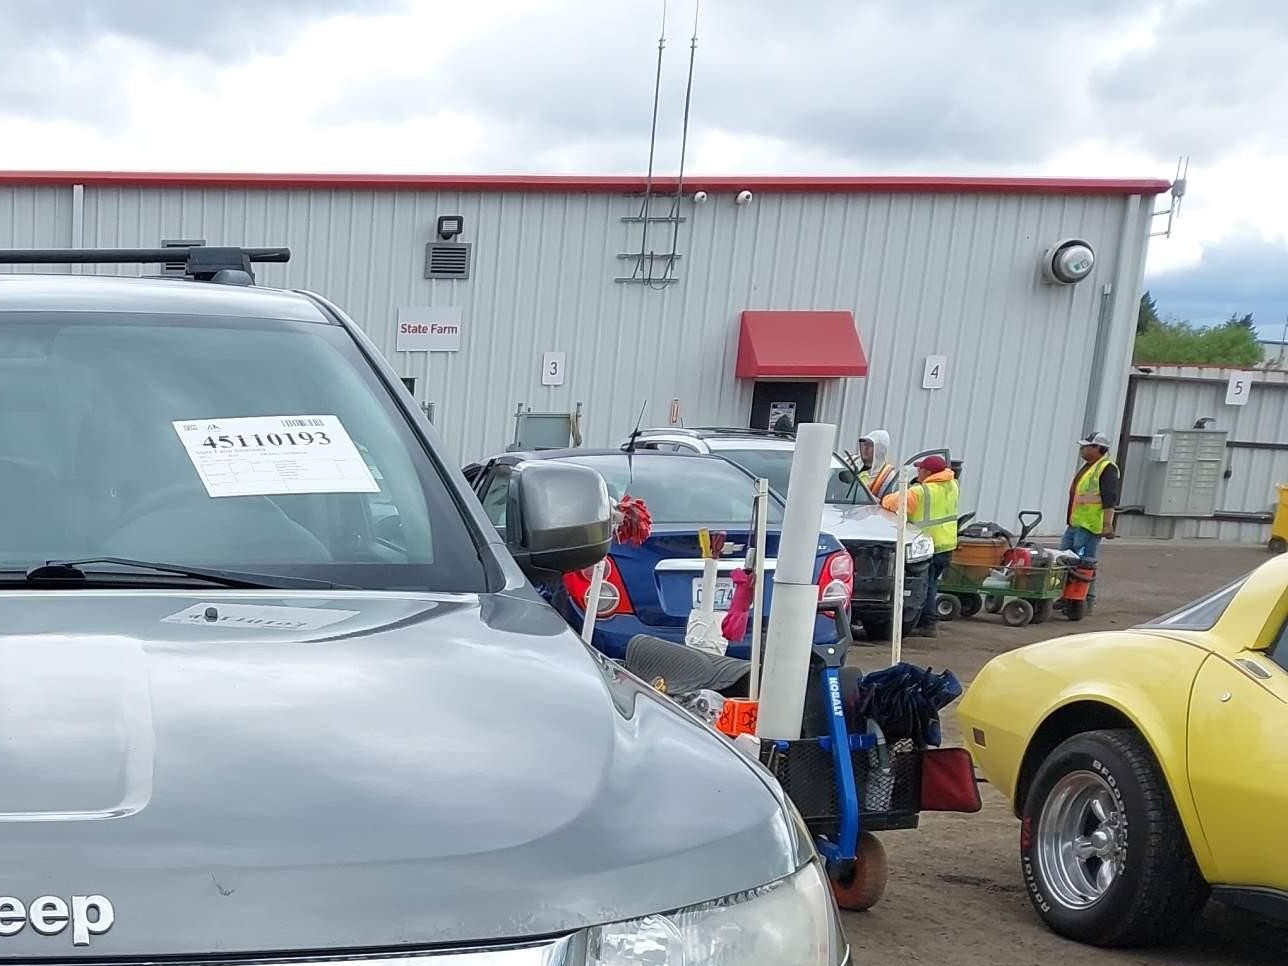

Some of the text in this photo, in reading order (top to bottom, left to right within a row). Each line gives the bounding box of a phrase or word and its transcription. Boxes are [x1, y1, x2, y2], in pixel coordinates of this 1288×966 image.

[400, 323, 458, 334] State Farm
[549, 361, 558, 376] 3
[930, 364, 940, 379] 4
[1234, 381, 1244, 395] 5
[203, 431, 332, 448] 45110193
[829, 676, 843, 717] KOBALT
